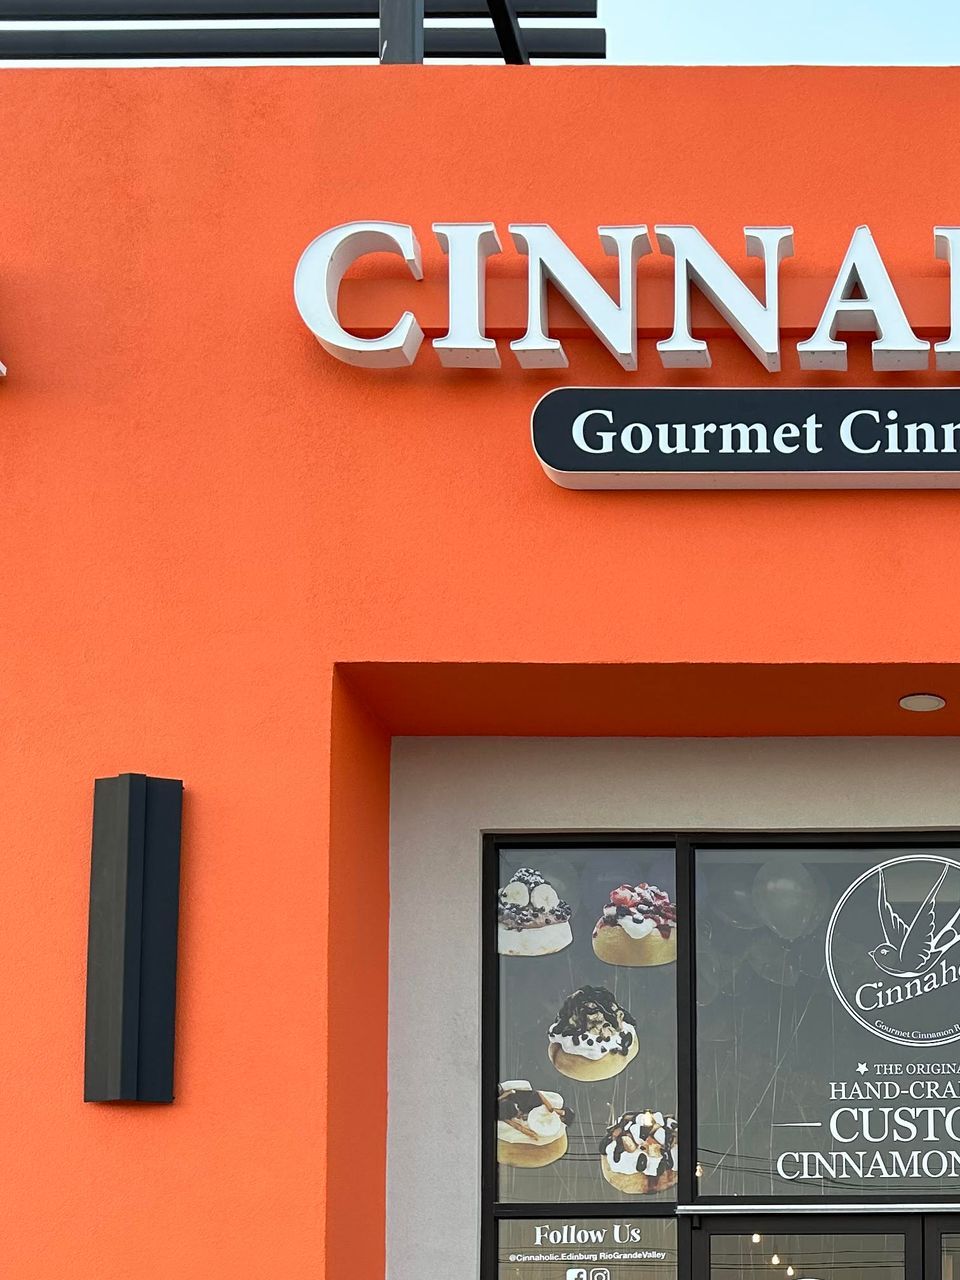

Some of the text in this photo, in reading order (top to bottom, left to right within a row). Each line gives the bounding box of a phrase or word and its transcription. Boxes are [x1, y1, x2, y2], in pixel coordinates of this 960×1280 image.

[571, 408, 823, 455] Gourmet
[874, 1019, 910, 1038] Gourmet
[911, 1028, 954, 1039] Cinnamon
[873, 1063, 903, 1075] THE
[534, 1223, 641, 1245] Follow Us
